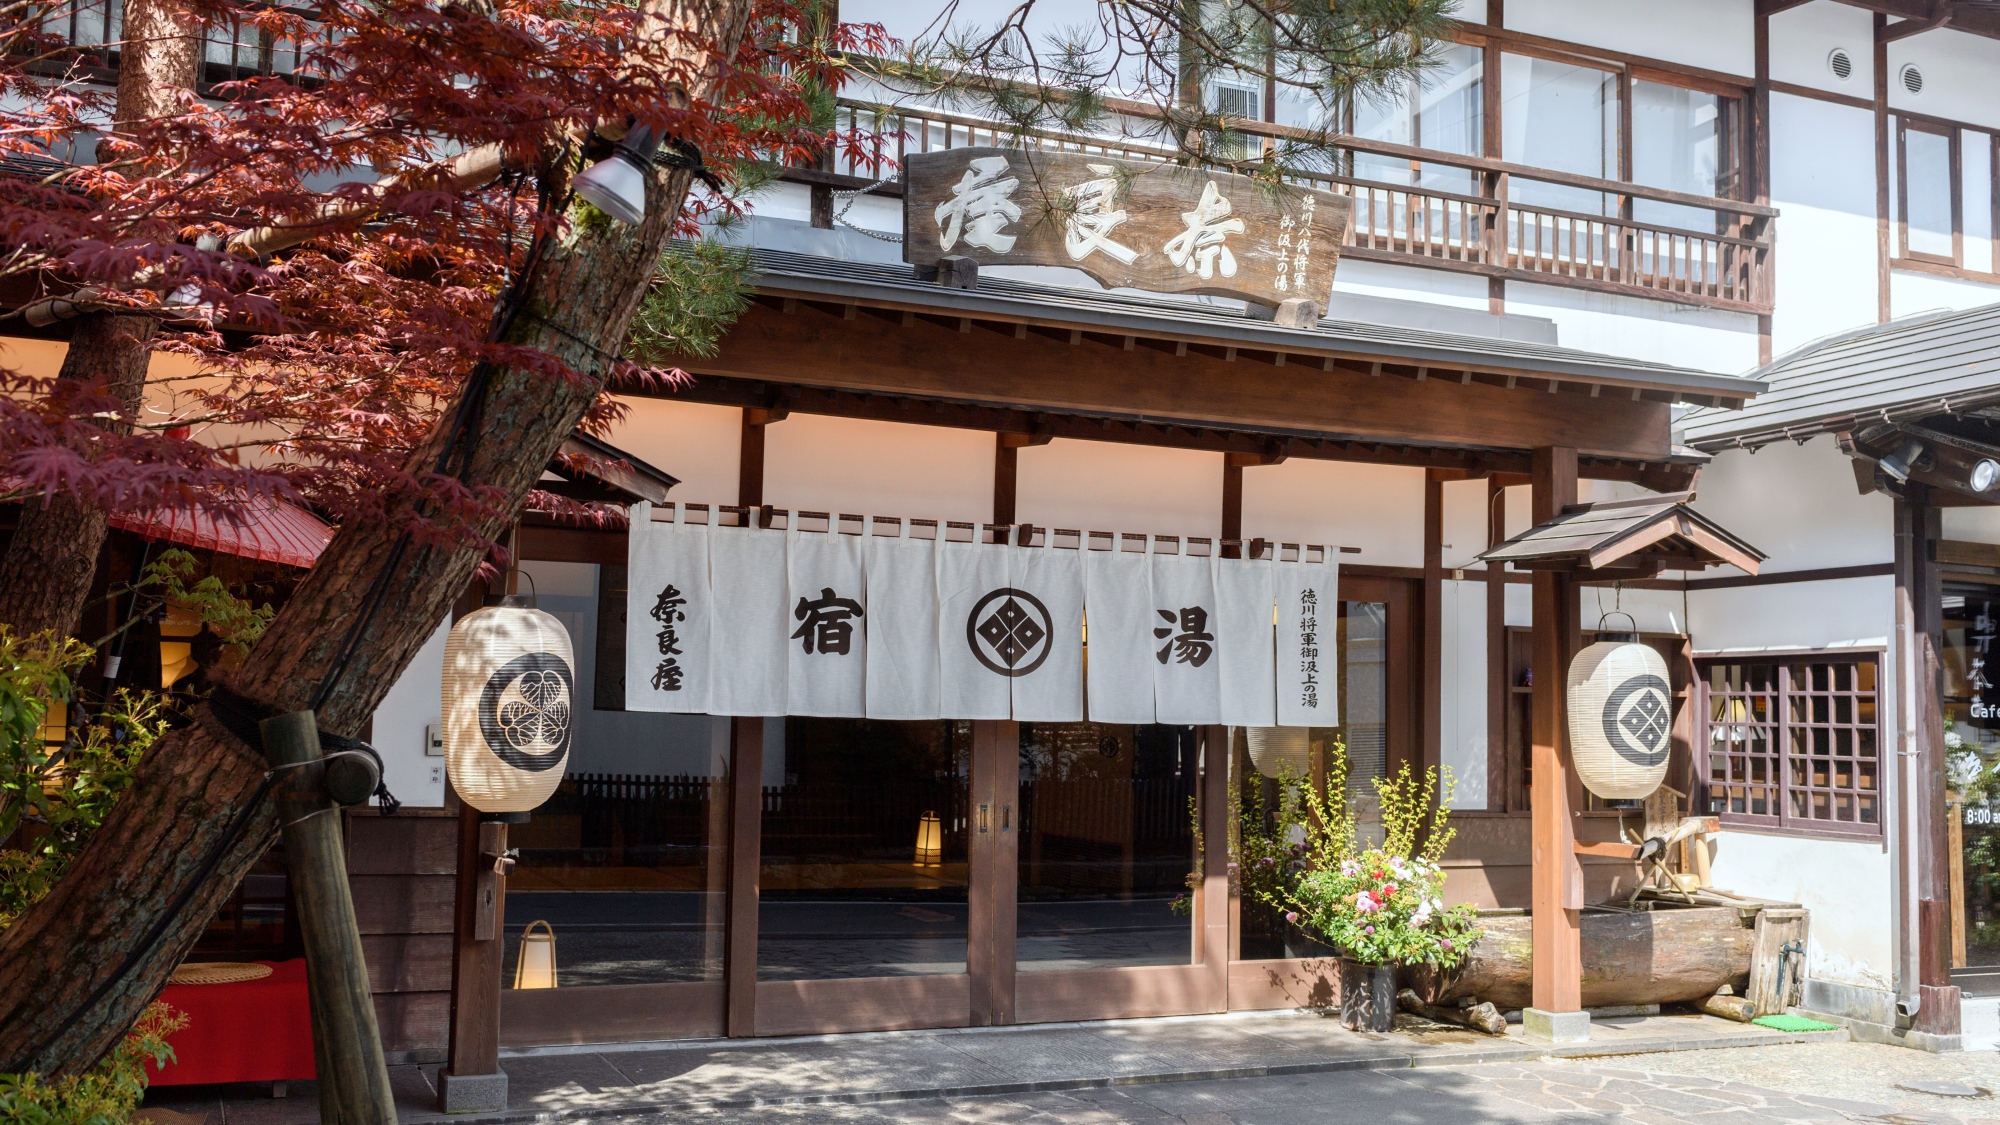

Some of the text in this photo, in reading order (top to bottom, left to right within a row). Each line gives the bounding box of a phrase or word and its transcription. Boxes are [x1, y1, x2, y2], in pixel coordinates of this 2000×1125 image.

[934, 155, 1246, 280] 奈良屋
[650, 583, 687, 691] 奈良屋
[790, 587, 864, 655] 宿
[1153, 606, 1214, 667] 湯
[1300, 588, 1319, 709] 徳川将軍御汲上の湯
[1967, 809, 1991, 824] 8:00
